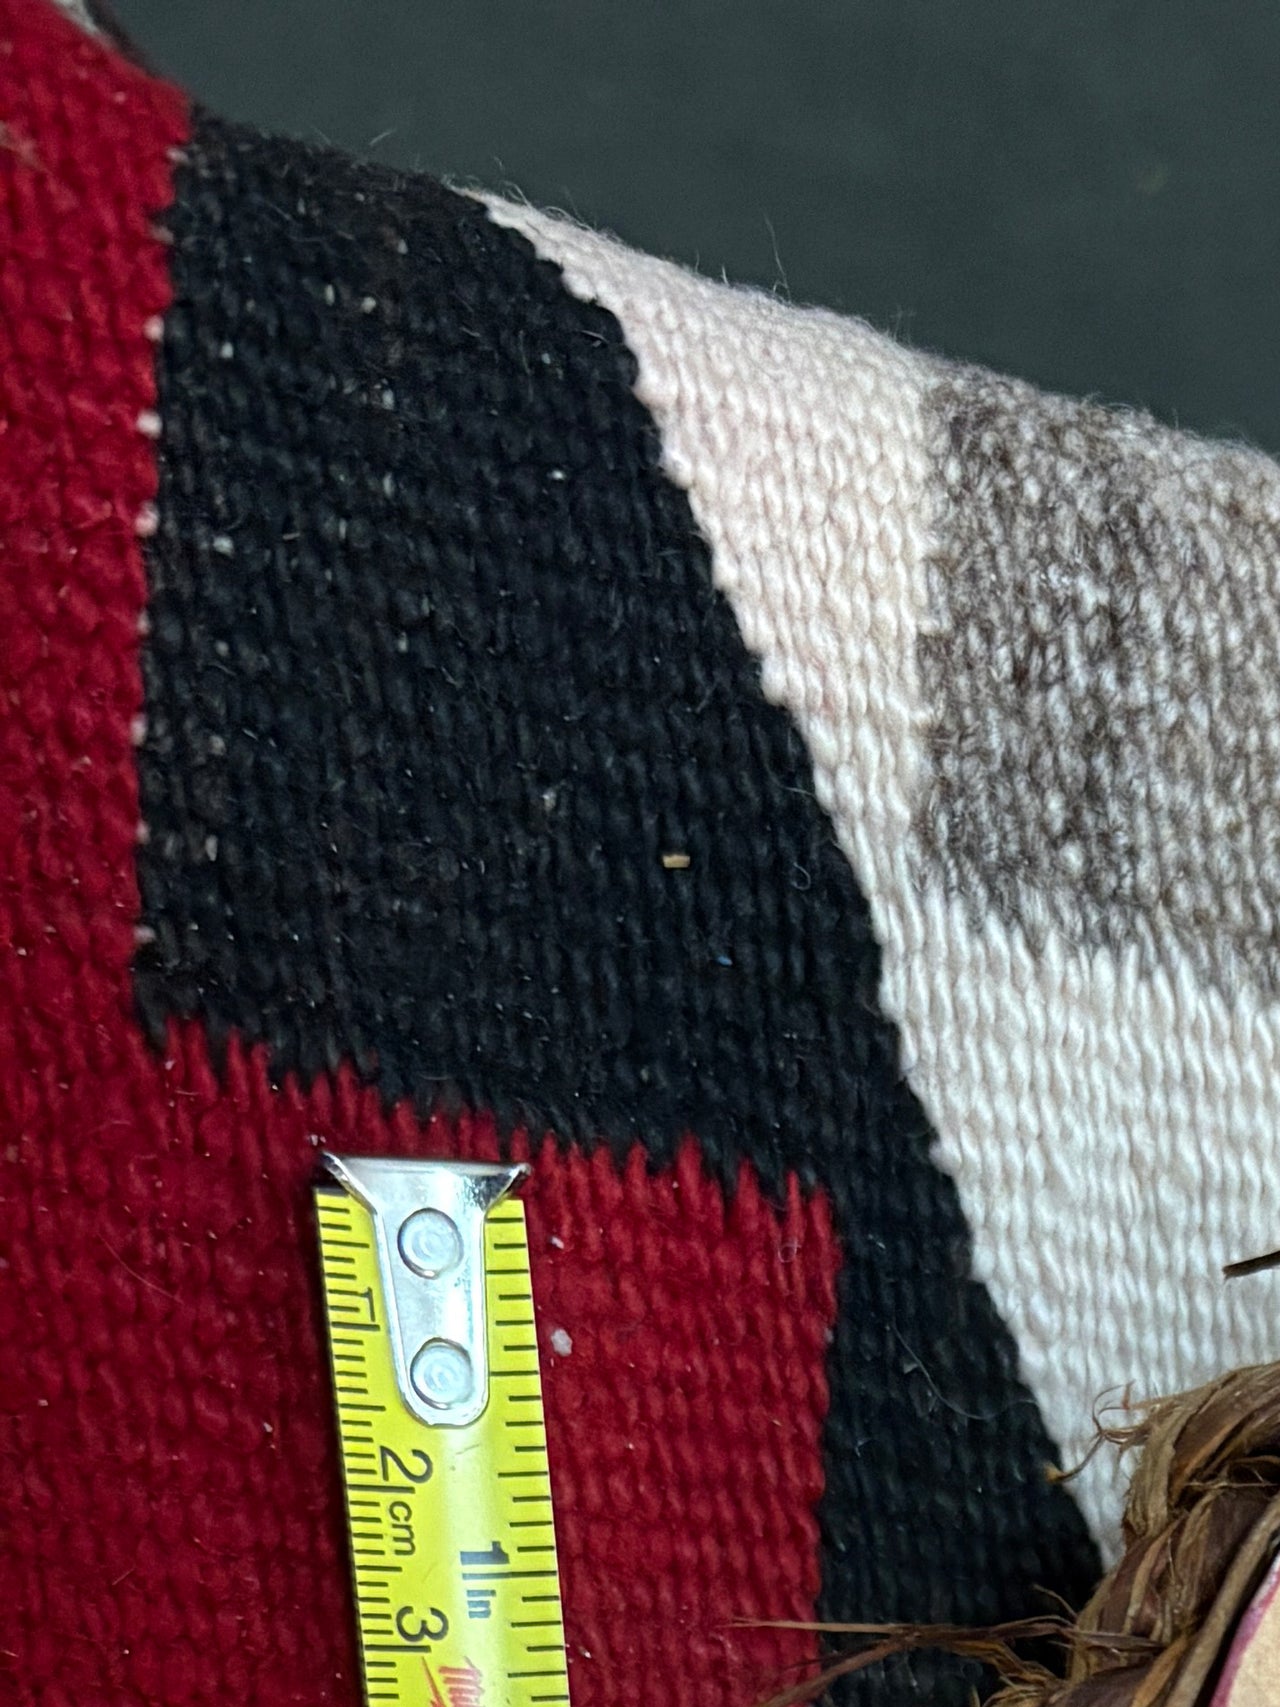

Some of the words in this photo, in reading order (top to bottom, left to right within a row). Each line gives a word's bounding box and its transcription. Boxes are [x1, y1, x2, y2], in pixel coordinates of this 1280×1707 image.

[379, 1445, 433, 1484] 2
[388, 1500, 416, 1556] cm
[460, 1540, 510, 1565] 1
[466, 1589, 497, 1619] in
[396, 1605, 449, 1642] 3
